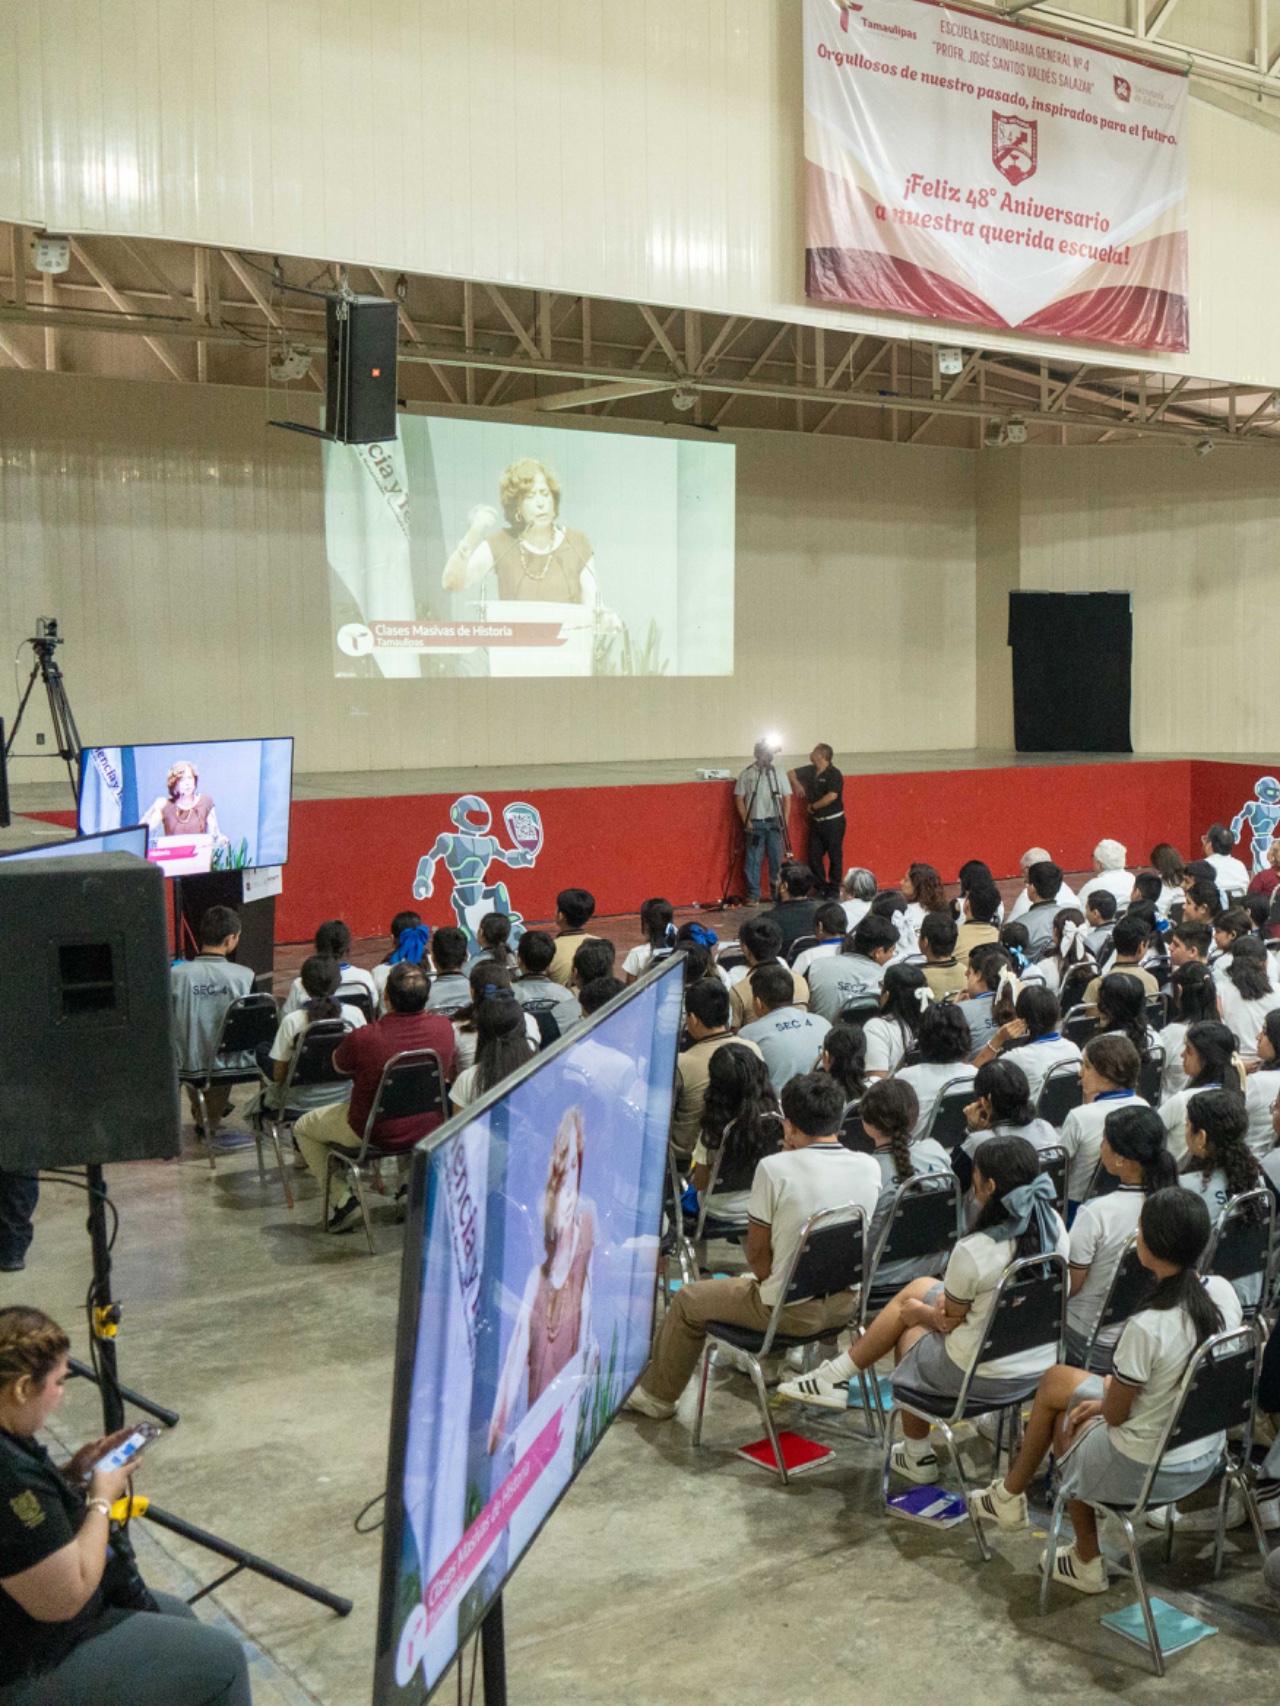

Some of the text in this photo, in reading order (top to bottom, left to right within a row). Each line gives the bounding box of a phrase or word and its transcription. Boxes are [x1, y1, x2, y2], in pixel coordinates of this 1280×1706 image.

[861, 17, 917, 40] Tamaulipas
[940, 20, 979, 42] ESCUELA
[980, 31, 1034, 55] SECUNDARIA
[1035, 46, 1071, 67] GENERAL
[1084, 60, 1090, 72] 4
[968, 51, 990, 68] JOSÉ
[992, 57, 1025, 76] SANTOS
[1027, 65, 1057, 85] VALDÉS
[817, 43, 898, 76] Orgullosos
[900, 66, 918, 81] de
[921, 71, 974, 94] nuestro
[976, 84, 1029, 109] pasado,
[1031, 96, 1098, 125] inspirados
[1100, 117, 1127, 134] para
[1129, 124, 1139, 137] el
[903, 173, 1110, 233] ¡Feliz 48° Aniversario
[875, 205, 1131, 266] a nuestra querida escuela!
[375, 624, 513, 637] Clases Masivas de Historia
[376, 638, 425, 648] Tamaulipas
[192, 984, 228, 997] SEC 4
[775, 1018, 813, 1032] SEC 4
